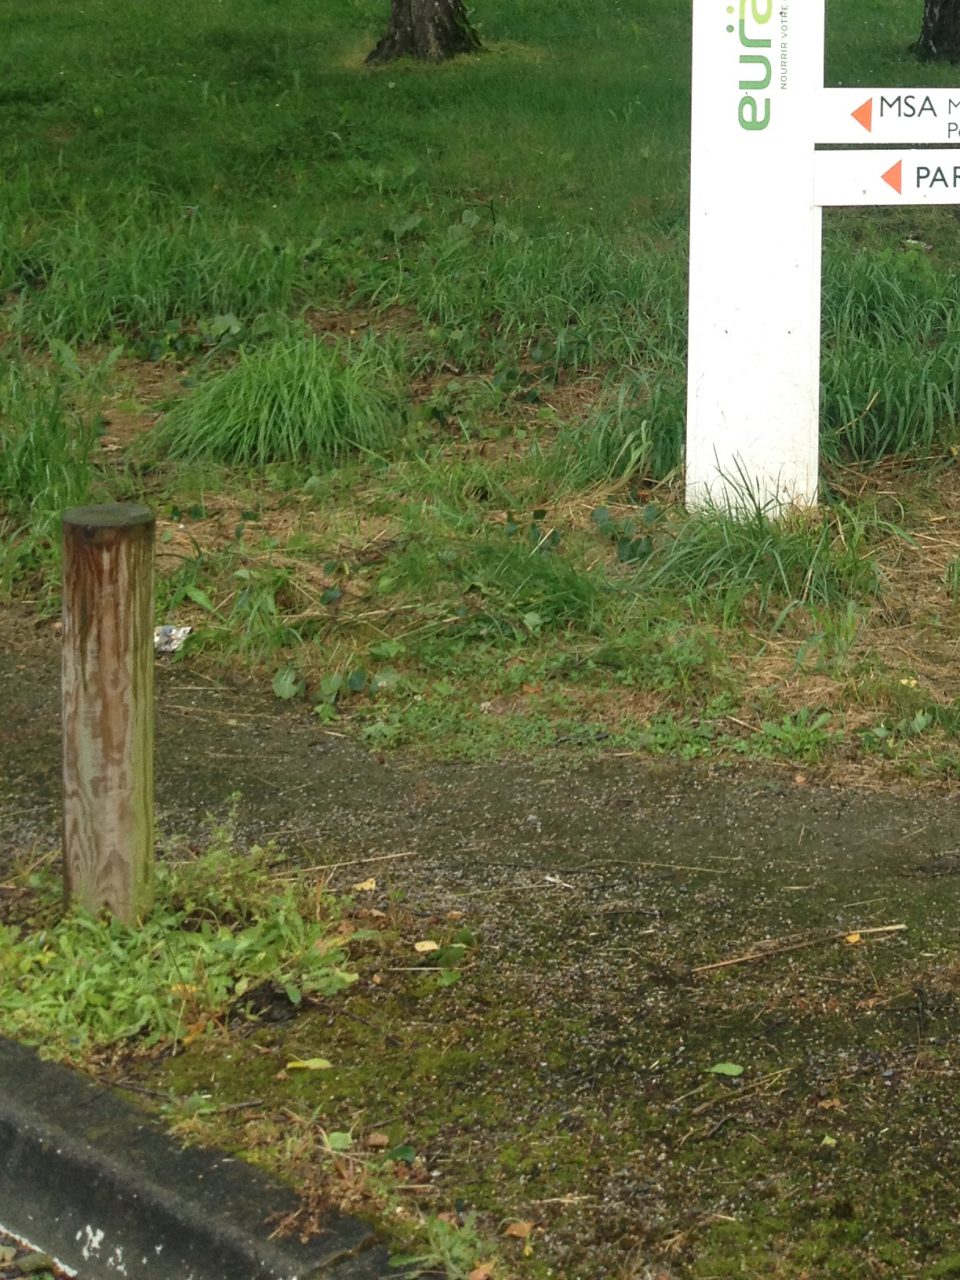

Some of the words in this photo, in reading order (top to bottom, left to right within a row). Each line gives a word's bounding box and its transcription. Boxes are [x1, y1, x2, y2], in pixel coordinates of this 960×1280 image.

[780, 4, 788, 39] VOTRE
[780, 42, 788, 91] NOURRIR
[879, 95, 938, 117] MSA
